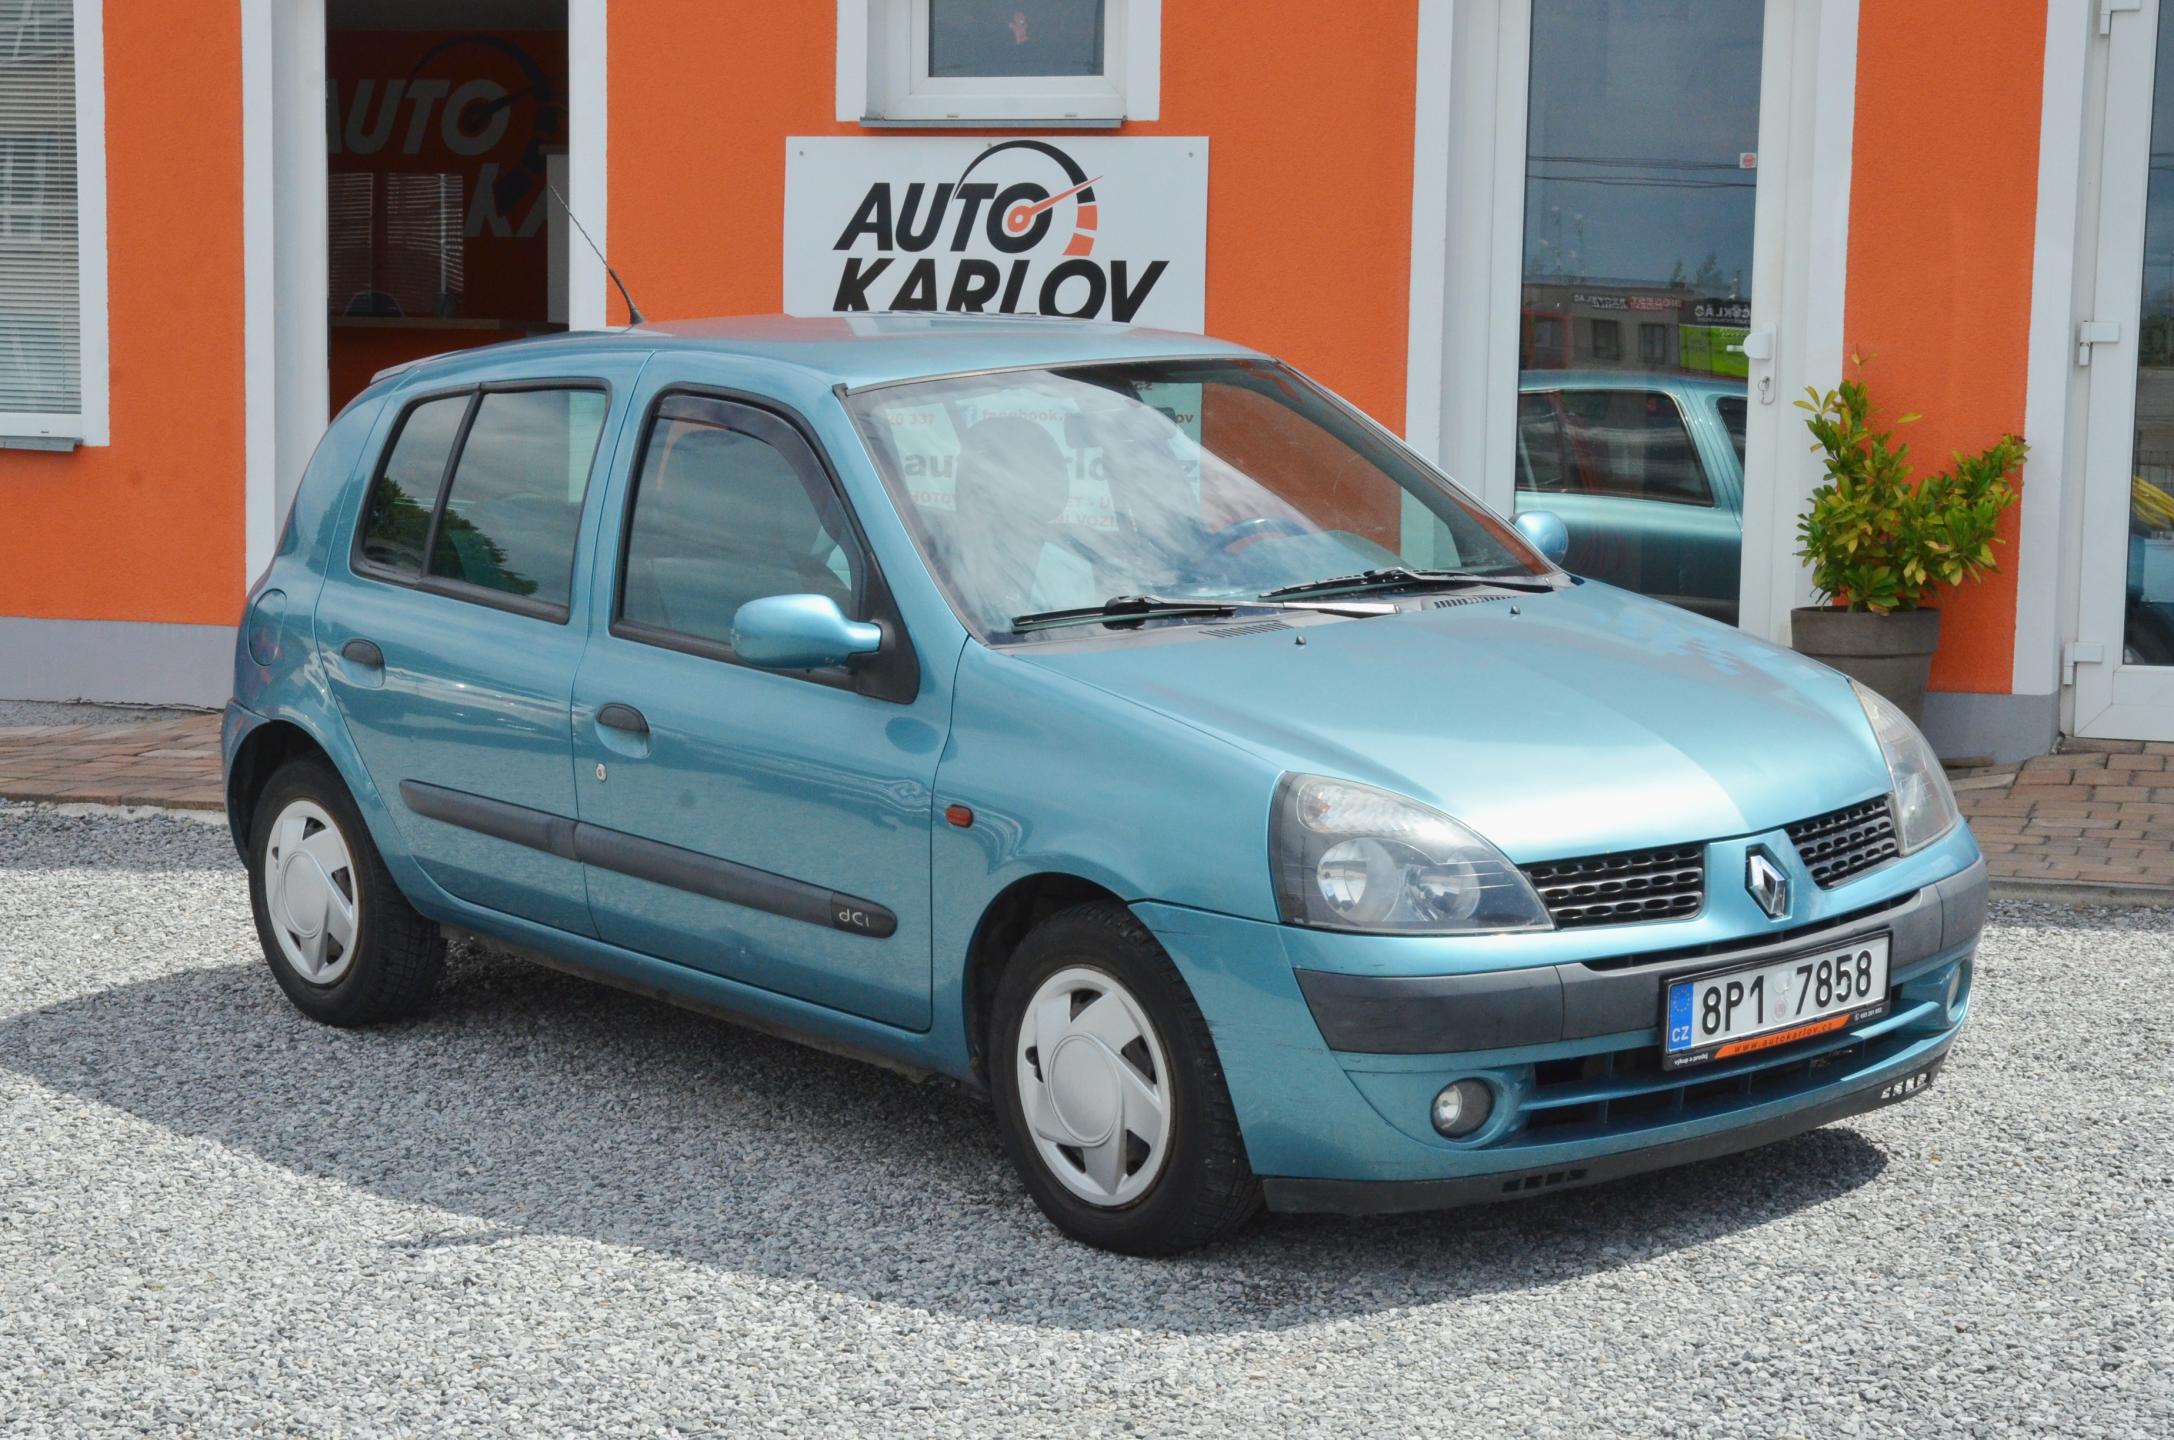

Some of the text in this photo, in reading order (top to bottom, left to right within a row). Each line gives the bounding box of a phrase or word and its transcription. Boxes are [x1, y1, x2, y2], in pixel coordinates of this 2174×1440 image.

[832, 181, 1054, 254] AUTO
[832, 257, 1170, 324] KARLOV
[1701, 949, 1873, 1036] 8P1 7858
[1671, 1025, 1690, 1043] CZ
[1733, 1022, 1833, 1054] www.autokarlov.cz
